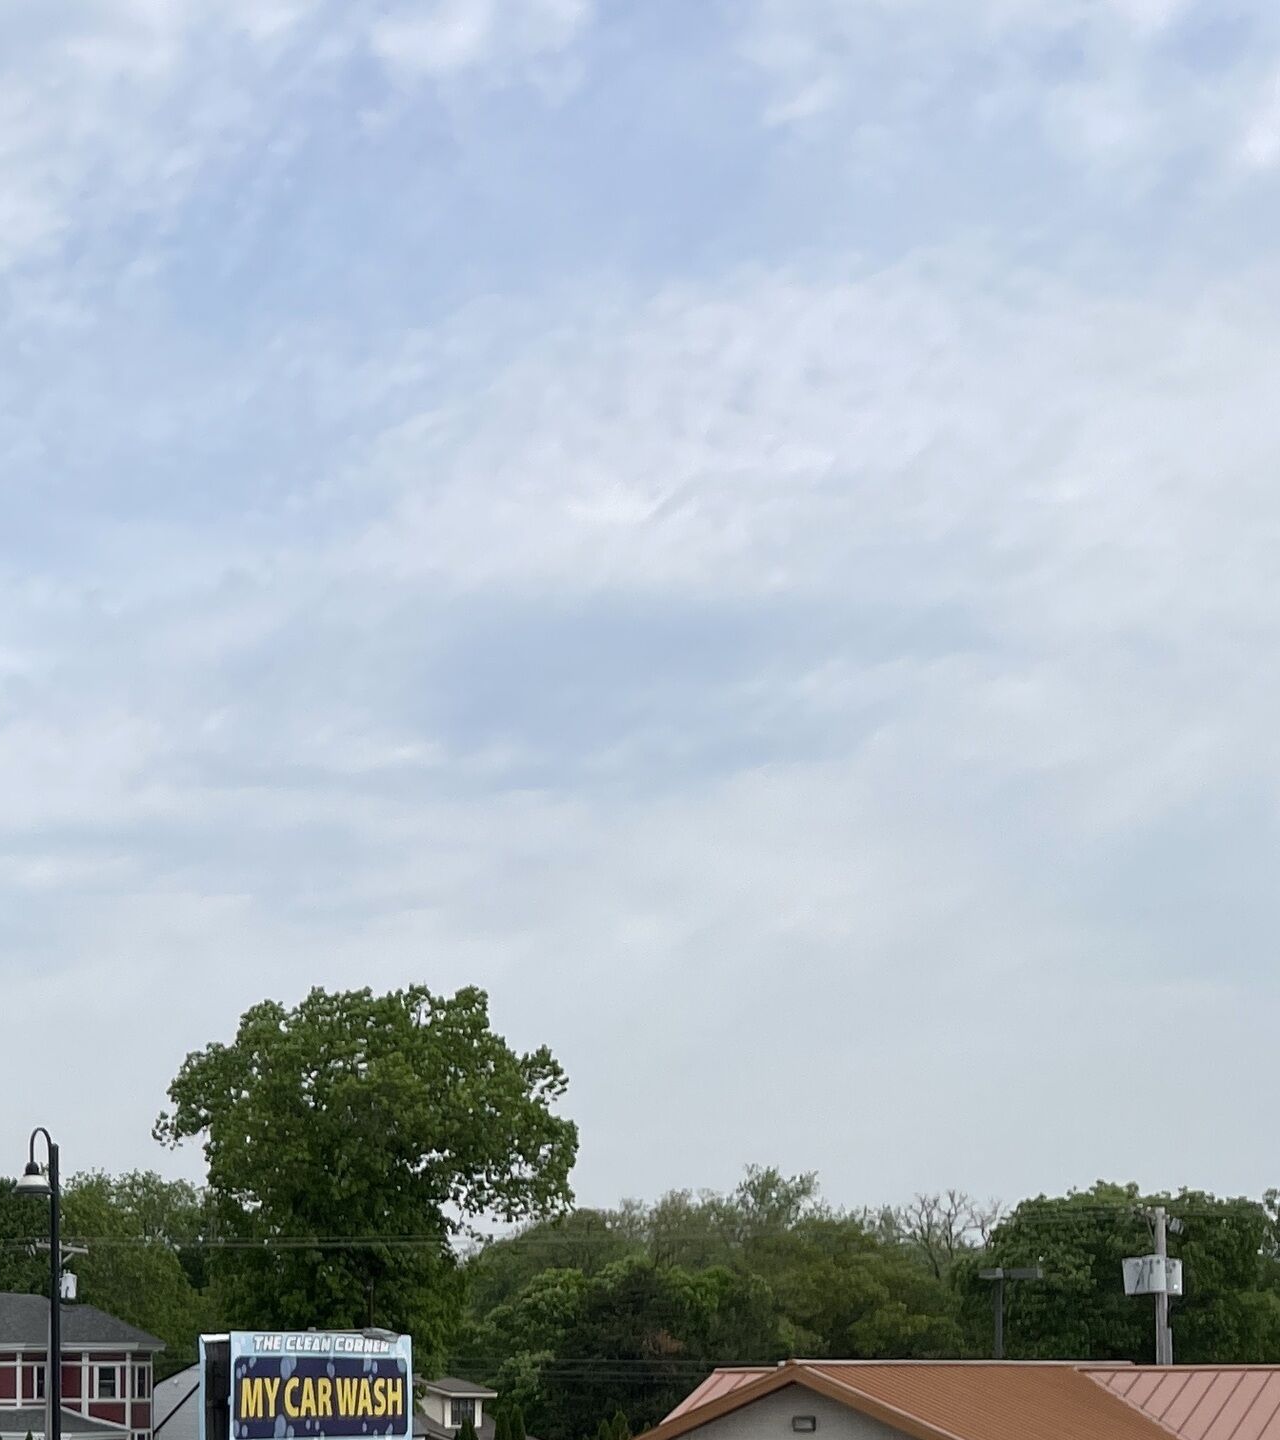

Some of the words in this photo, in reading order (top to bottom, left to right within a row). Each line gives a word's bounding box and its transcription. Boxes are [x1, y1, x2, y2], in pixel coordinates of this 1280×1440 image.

[253, 1335, 282, 1351] THE
[285, 1336, 332, 1353] CLEAN
[334, 1337, 390, 1354] CORNER
[240, 1376, 281, 1419] MY
[284, 1376, 333, 1418] CAR
[336, 1376, 403, 1416] WASH
